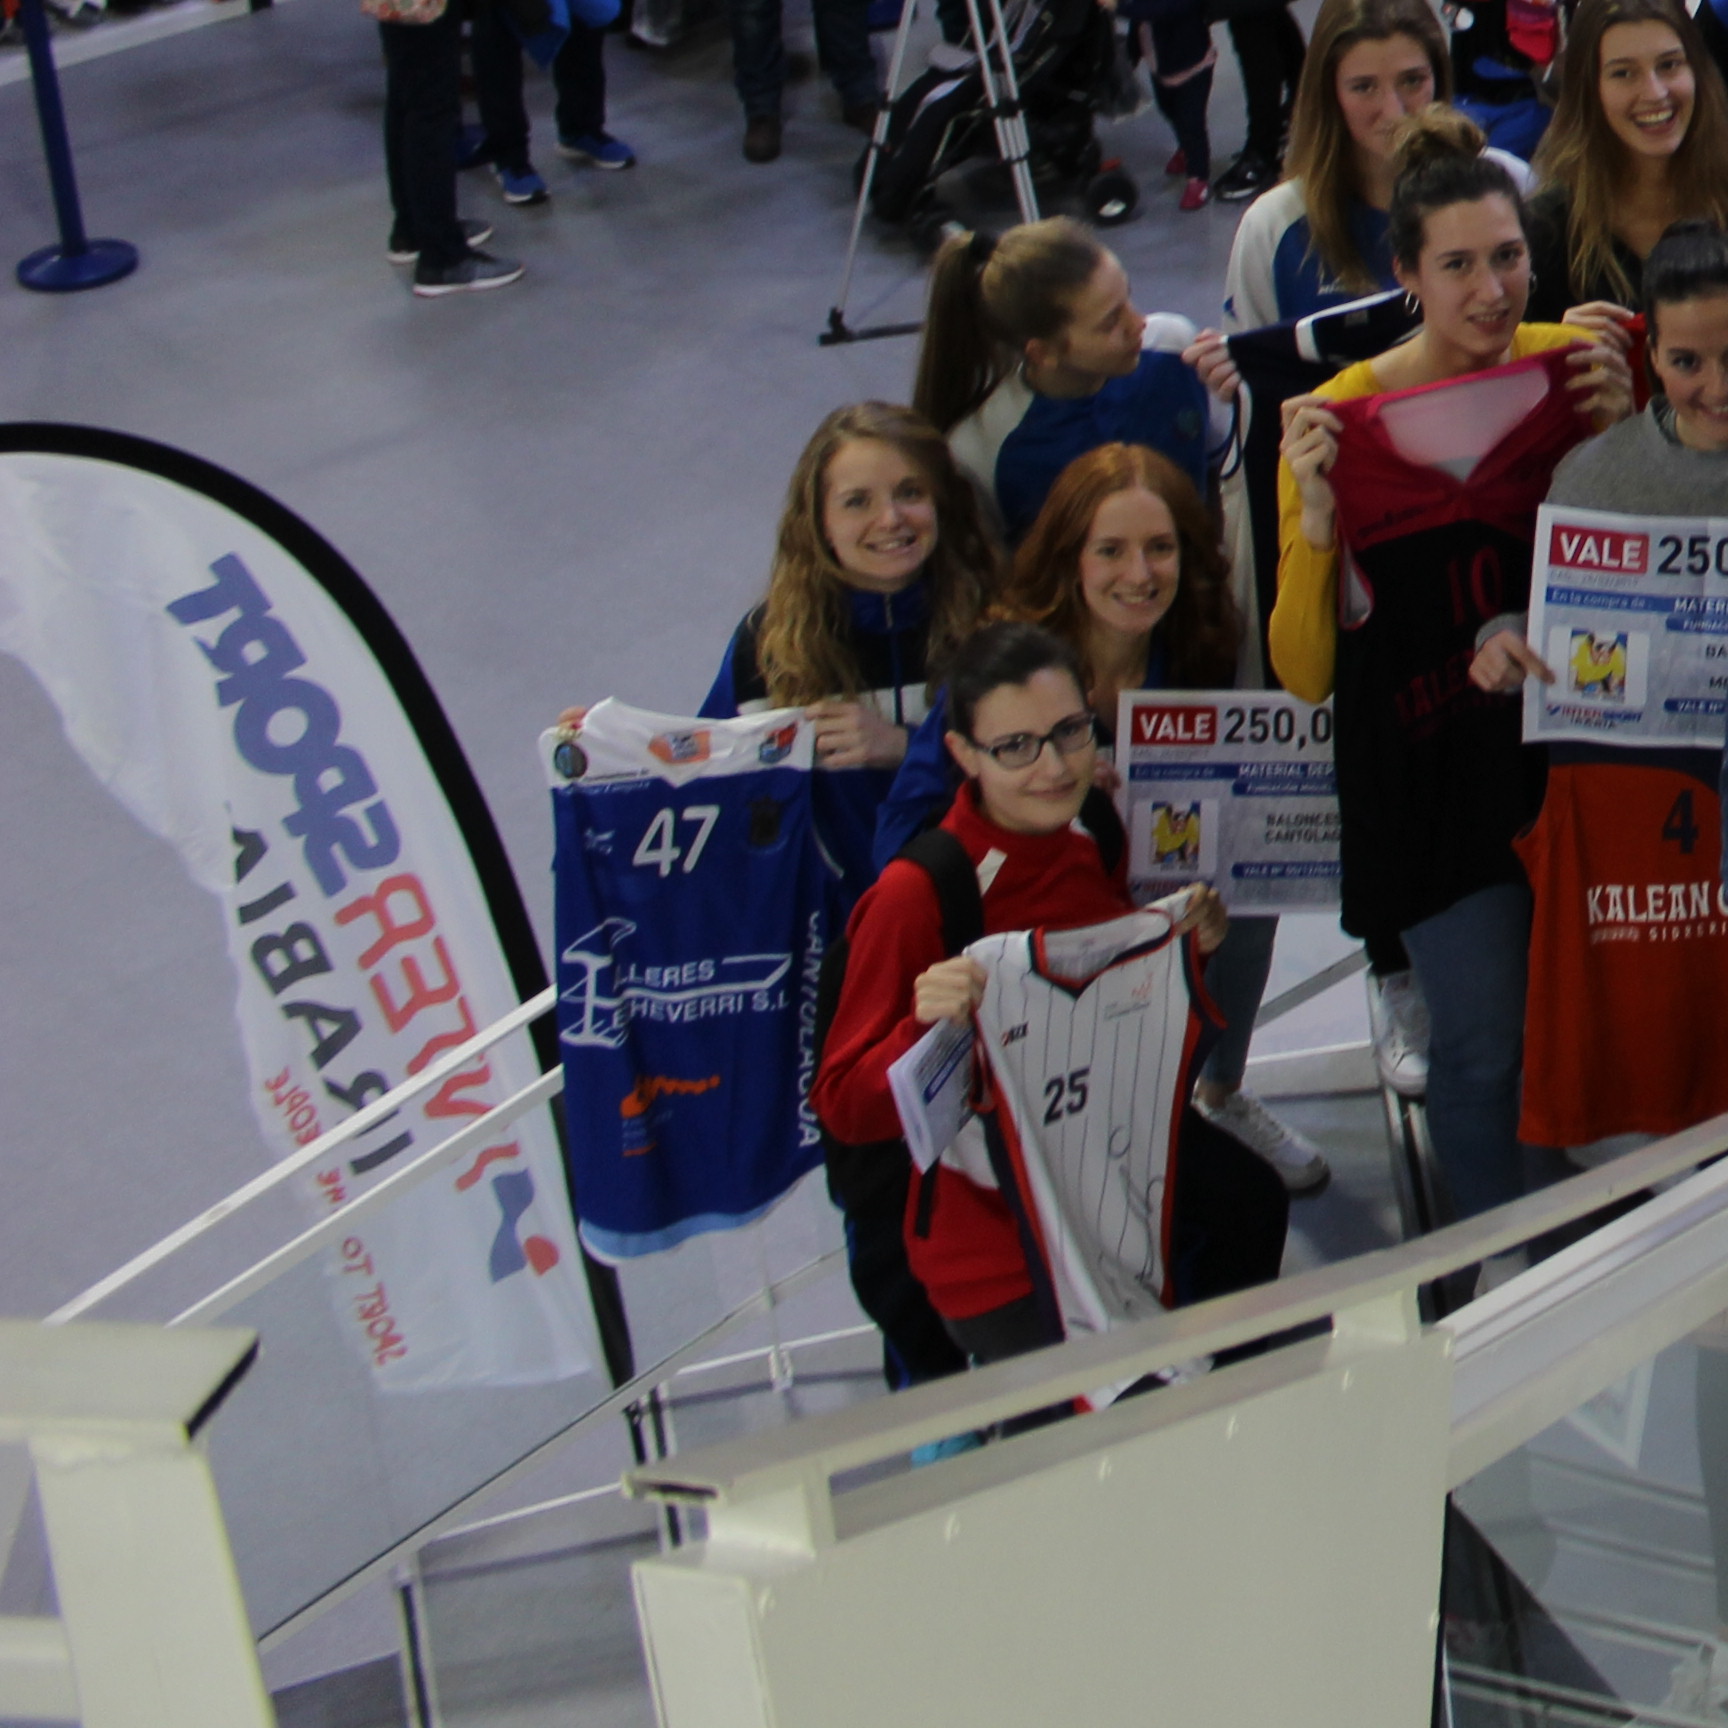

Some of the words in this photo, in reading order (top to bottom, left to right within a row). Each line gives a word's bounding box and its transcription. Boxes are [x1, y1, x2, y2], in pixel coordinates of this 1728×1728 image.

[1560, 531, 1642, 570] VALE
[1139, 712, 1212, 740] VALE
[1223, 706, 1333, 751] 250,0
[633, 804, 721, 878] 47
[1661, 787, 1698, 855] 4
[1587, 881, 1710, 926] KALEAN
[1043, 1065, 1090, 1129] 25
